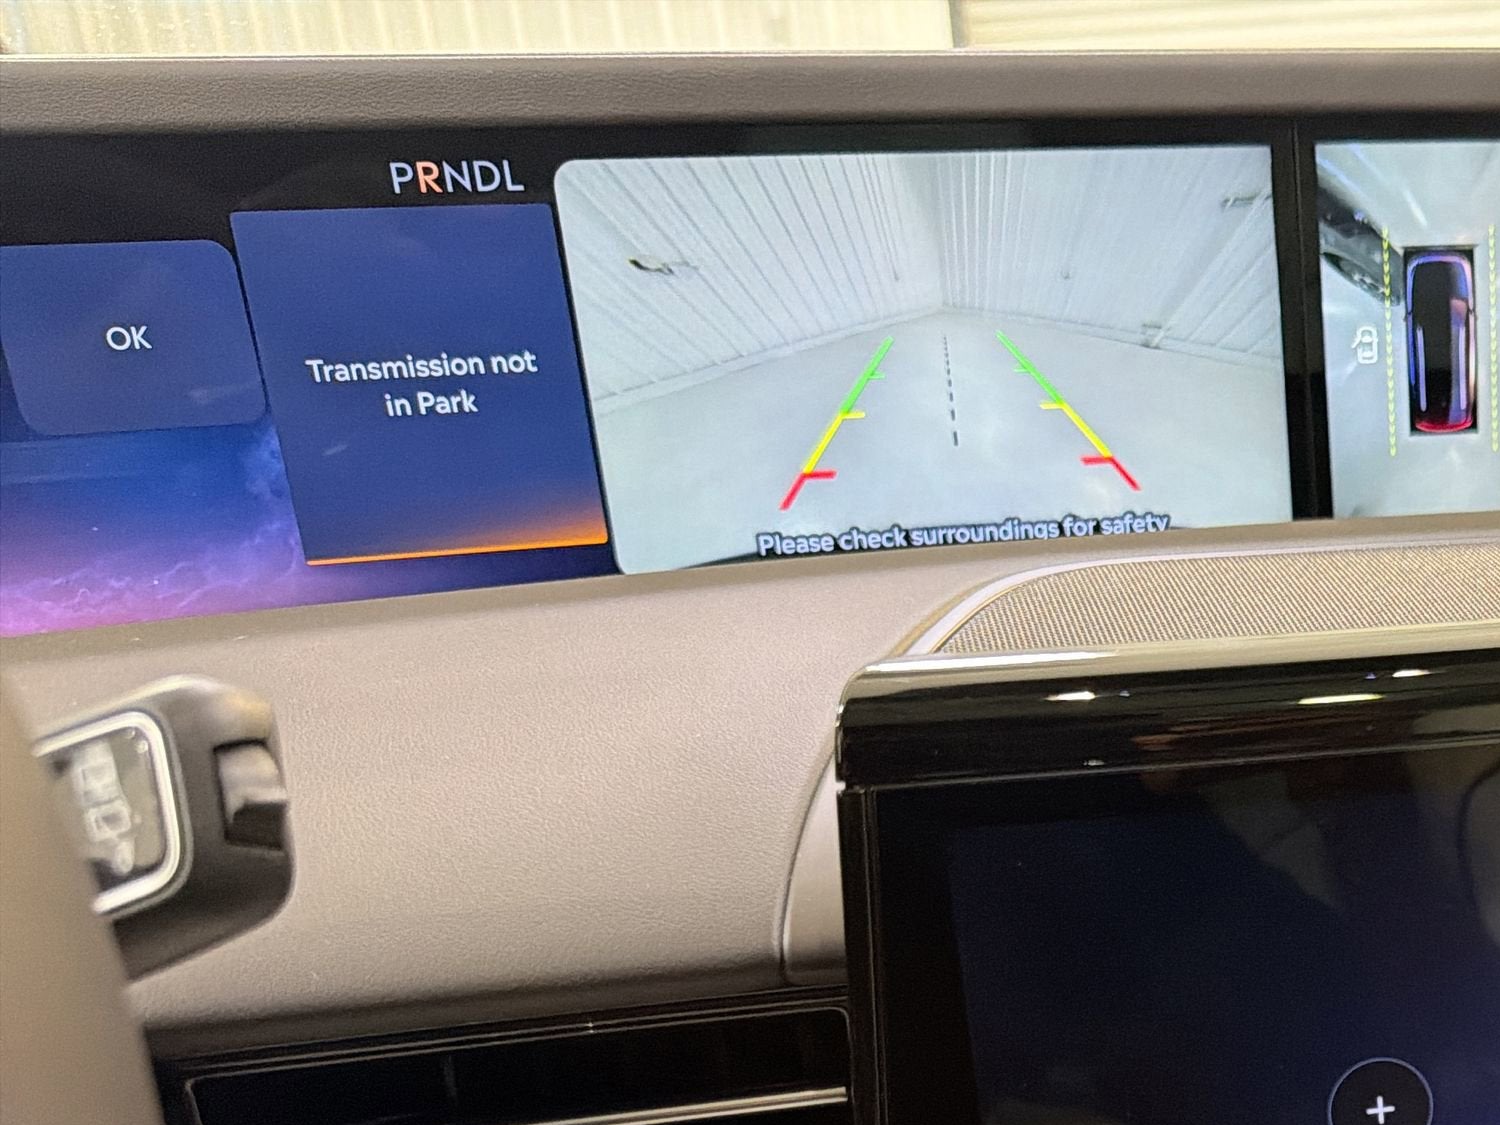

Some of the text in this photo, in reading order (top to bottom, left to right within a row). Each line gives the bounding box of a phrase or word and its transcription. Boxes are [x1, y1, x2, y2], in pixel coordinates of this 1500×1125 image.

[389, 160, 525, 194] PRNDL
[105, 325, 153, 352] OK
[304, 350, 539, 384] Transmission not
[384, 389, 479, 418] in Park
[758, 532, 836, 557] Please
[838, 525, 908, 551] check
[1062, 516, 1097, 538] for
